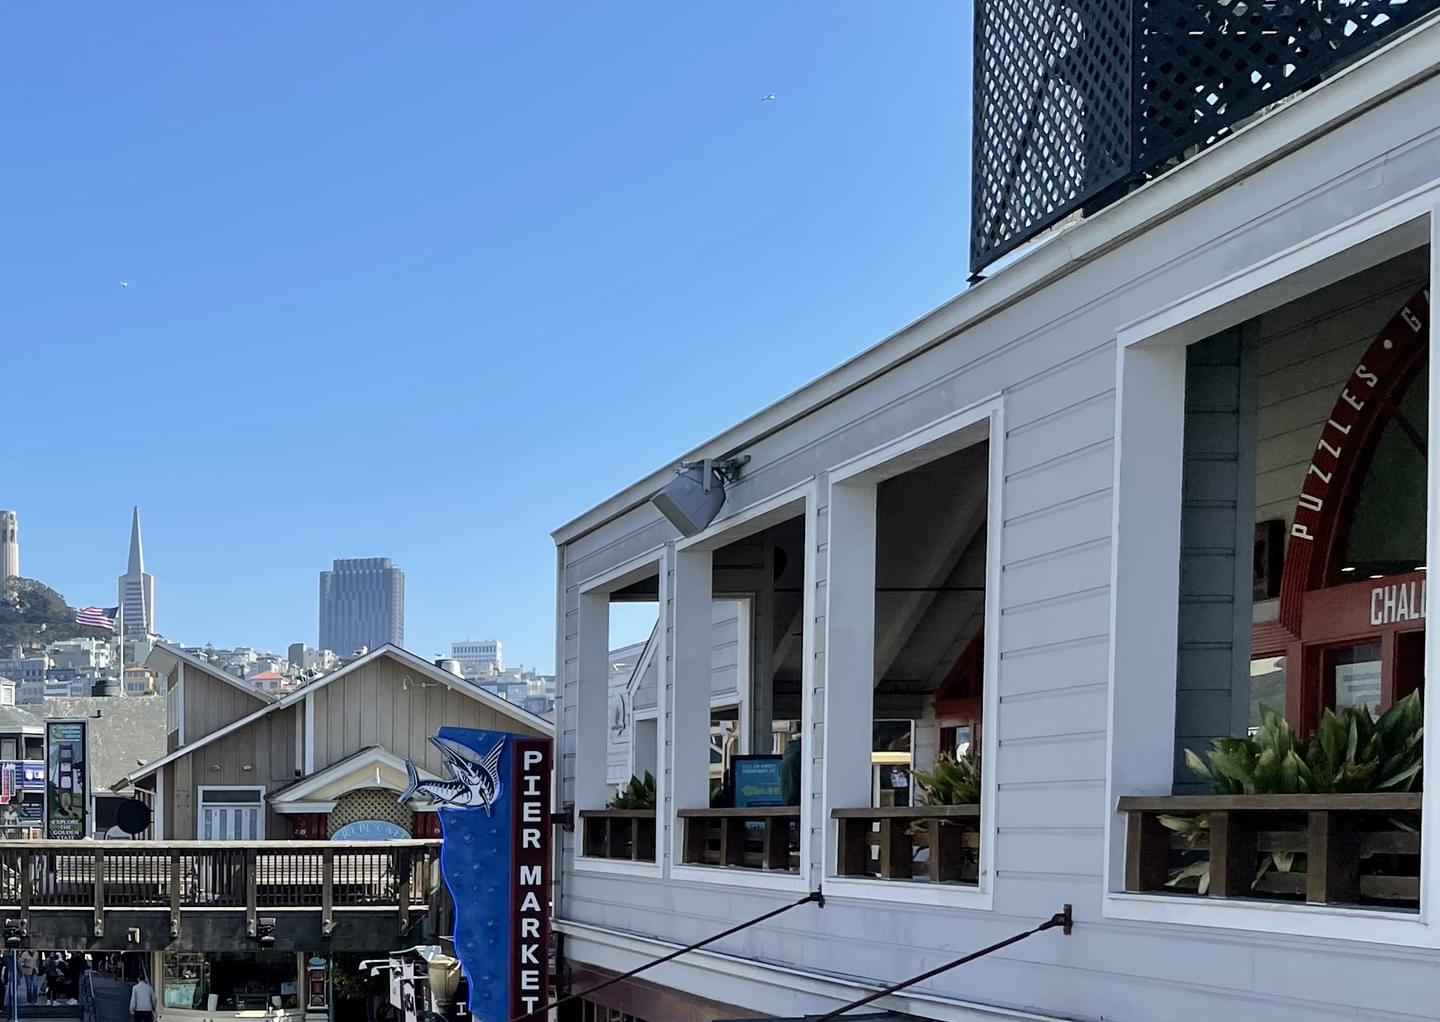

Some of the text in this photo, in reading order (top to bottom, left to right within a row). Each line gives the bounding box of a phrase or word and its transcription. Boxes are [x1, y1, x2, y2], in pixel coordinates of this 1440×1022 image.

[1290, 364, 1379, 541] PUZZLES
[519, 750, 543, 1016] PIER MARKET
